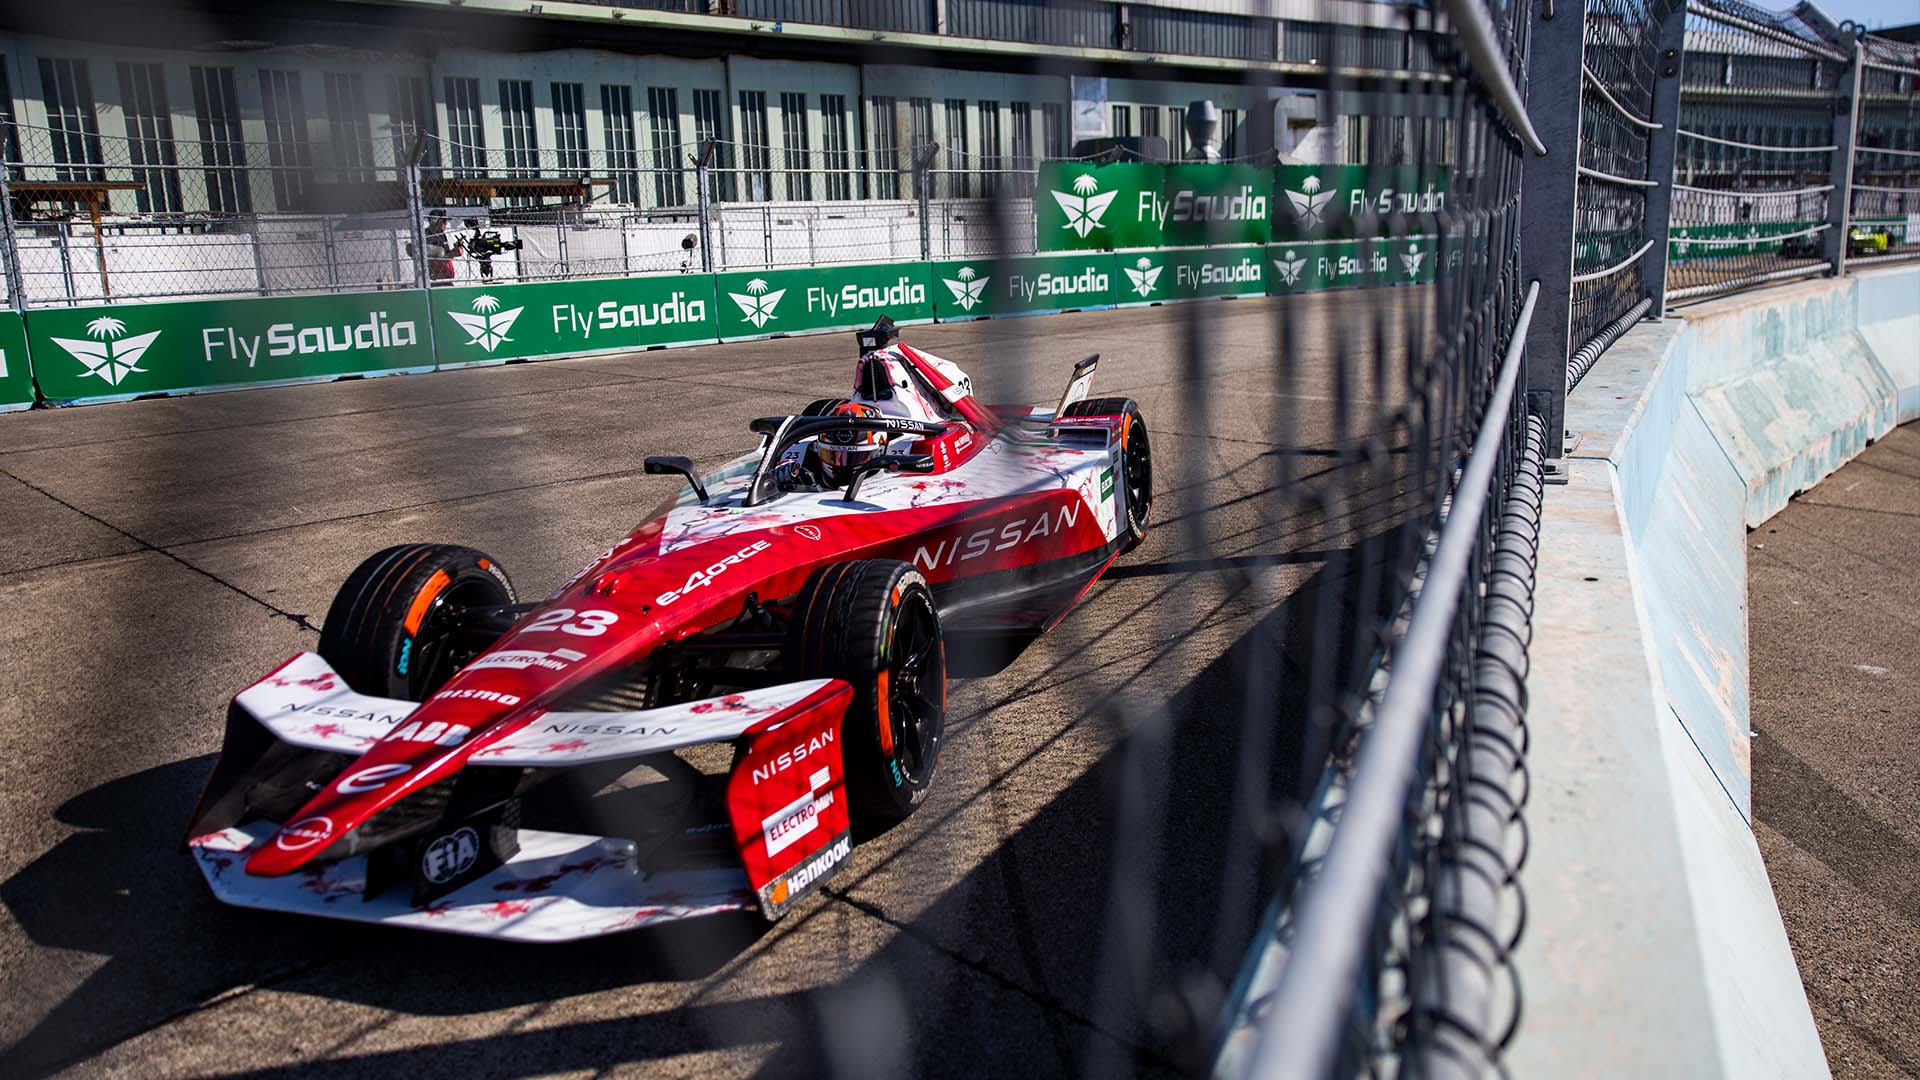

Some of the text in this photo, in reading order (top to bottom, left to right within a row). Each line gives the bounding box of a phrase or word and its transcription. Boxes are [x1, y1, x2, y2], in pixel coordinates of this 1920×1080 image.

[1173, 186, 1266, 221] Saudia
[1009, 267, 1109, 302] Fly Saudia
[1176, 258, 1261, 291] Fly Saudia
[552, 292, 706, 338] Fly Saudia
[807, 277, 926, 318] Fly Saudia
[202, 311, 417, 367] Fly Saudia
[885, 419, 925, 431] NISSAN
[786, 451, 799, 459] 23
[912, 500, 1080, 570] NISSAN
[519, 608, 619, 637] 23
[280, 703, 403, 724] NISSAN
[542, 724, 678, 735] NISSAN
[383, 721, 472, 747] ABB
[752, 728, 834, 785] NISSAN
[427, 834, 475, 878] FIA
